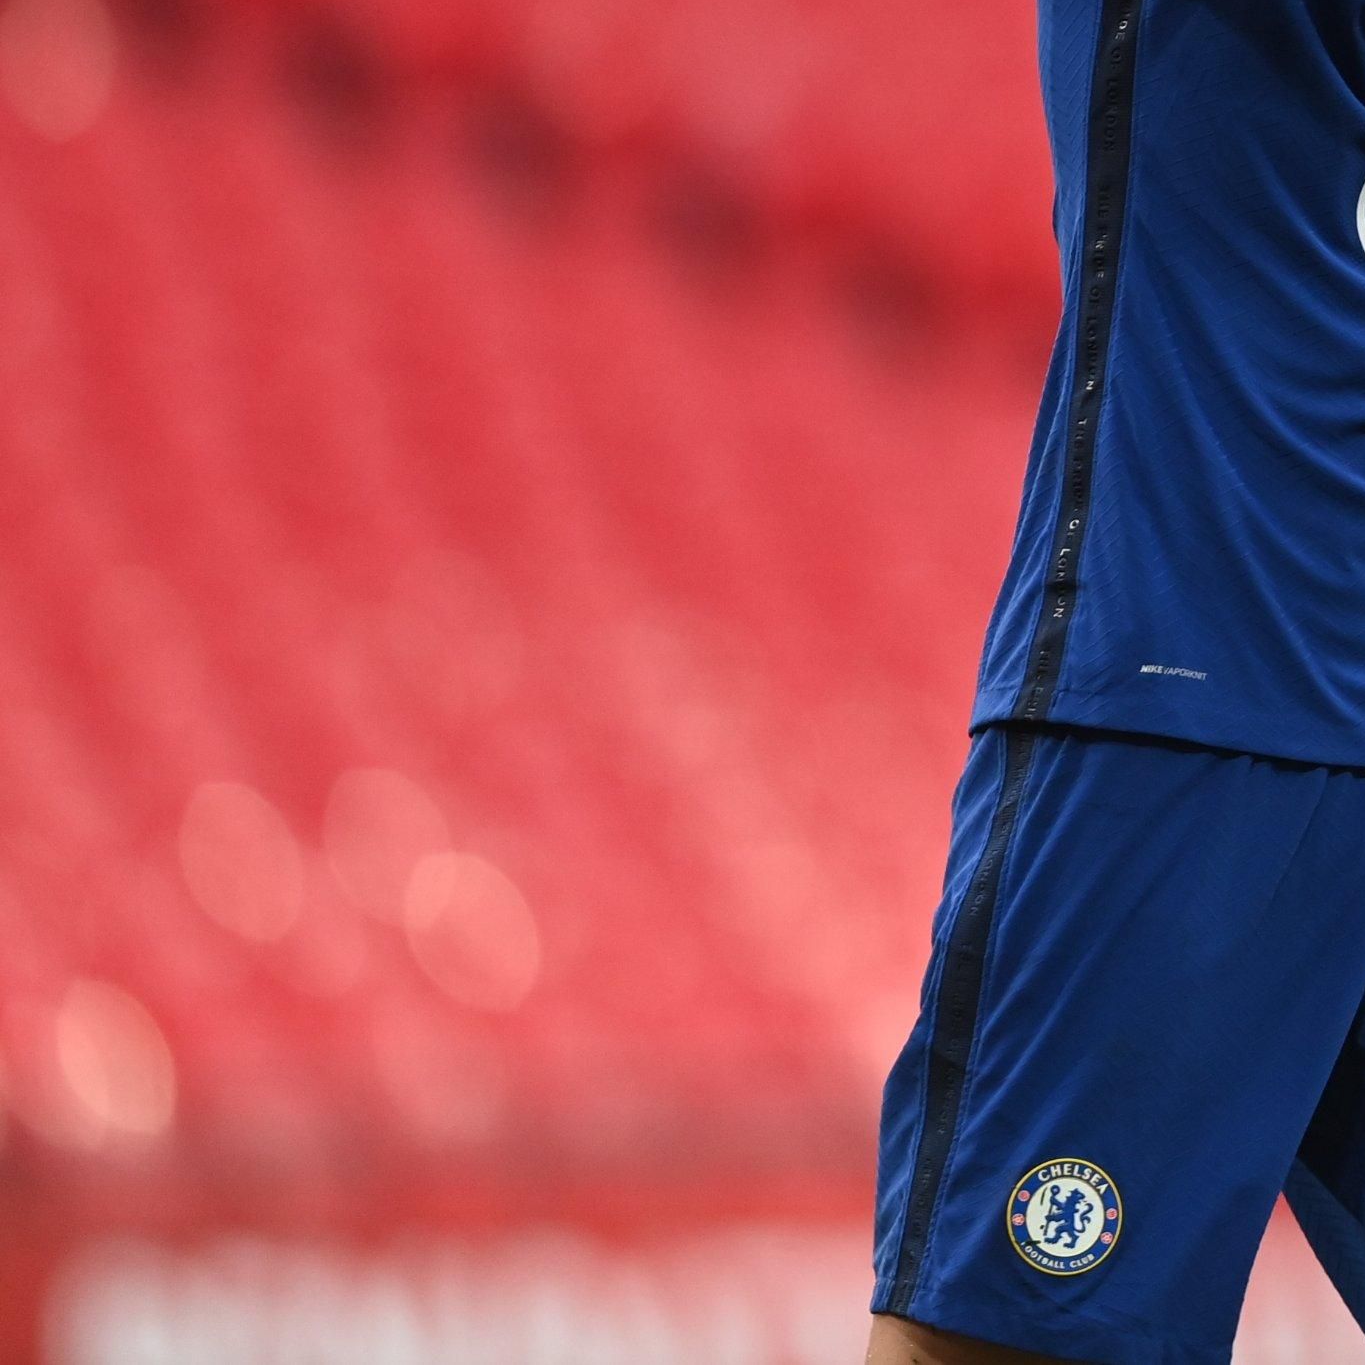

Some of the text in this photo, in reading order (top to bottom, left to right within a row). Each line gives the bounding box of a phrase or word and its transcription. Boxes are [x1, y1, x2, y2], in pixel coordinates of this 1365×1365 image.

[1140, 665, 1163, 673] NIKE
[1038, 1163, 1109, 1195] CHELSEA
[1021, 1241, 1095, 1269] OOTBALL CLUB
